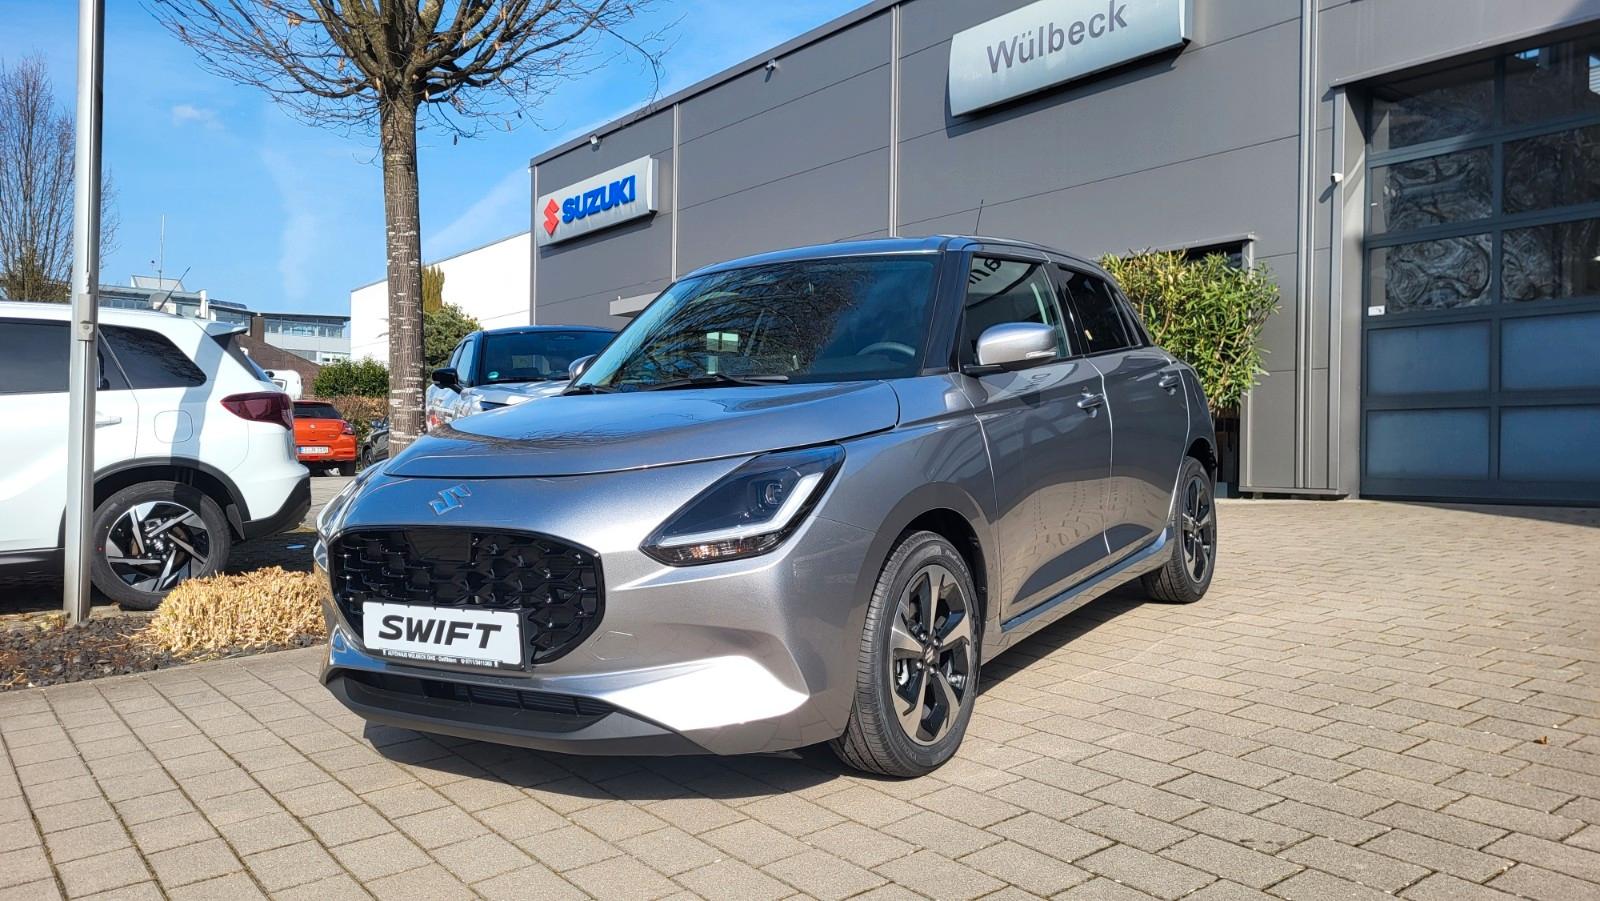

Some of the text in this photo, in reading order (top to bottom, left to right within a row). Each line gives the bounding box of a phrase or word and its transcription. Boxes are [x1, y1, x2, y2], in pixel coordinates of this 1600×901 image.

[986, 0, 1127, 74] Wülbeck
[562, 174, 635, 224] SUZUKI
[378, 615, 502, 649] SWIFT
